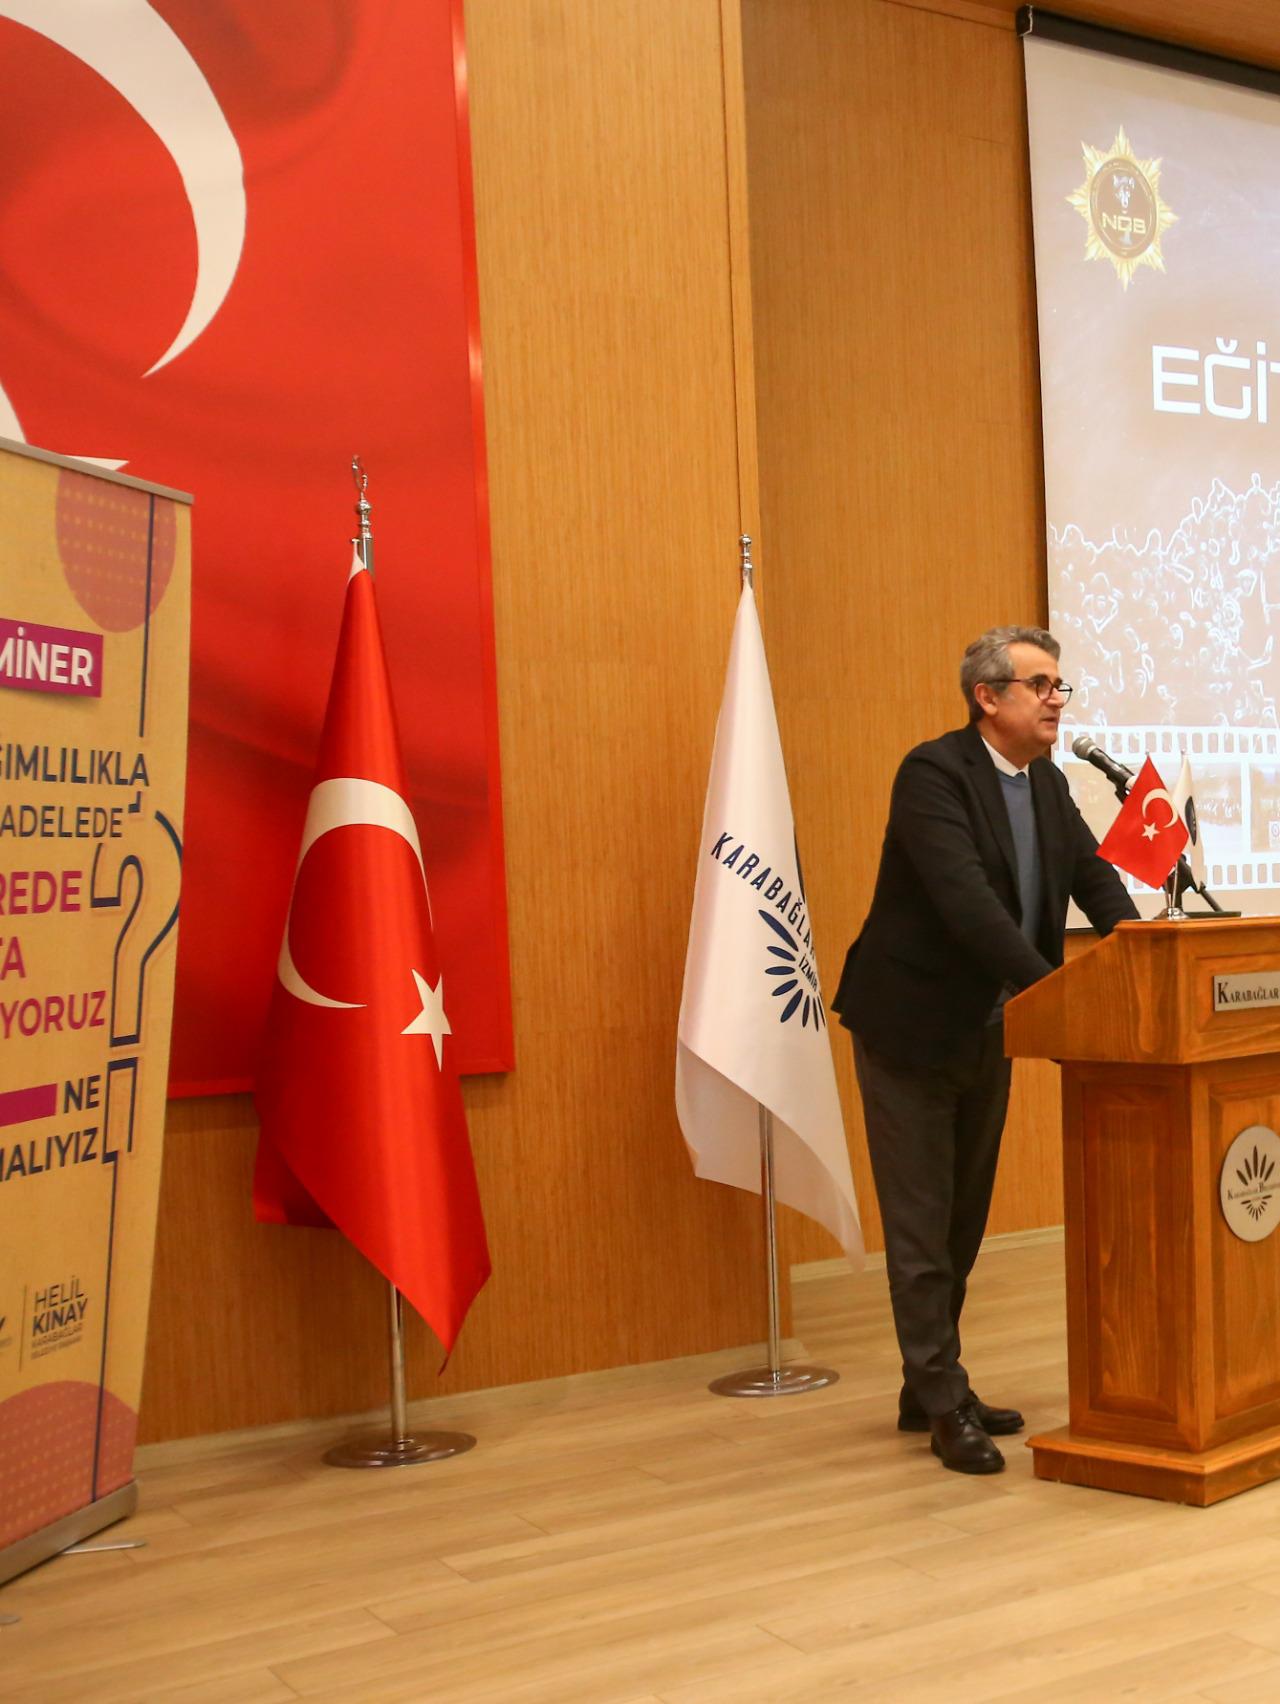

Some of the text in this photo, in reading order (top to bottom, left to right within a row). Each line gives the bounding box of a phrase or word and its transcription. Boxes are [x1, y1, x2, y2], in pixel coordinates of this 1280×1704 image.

[0, 743, 149, 787] IMLILIKLA
[0, 804, 123, 838] ADELEDE
[0, 936, 26, 981] A
[0, 990, 106, 1040] YORUZ
[63, 1074, 101, 1114] NE
[0, 1127, 99, 1183] ALIYIZ
[34, 1274, 85, 1313] HELİL
[32, 1297, 89, 1337] KINAY
